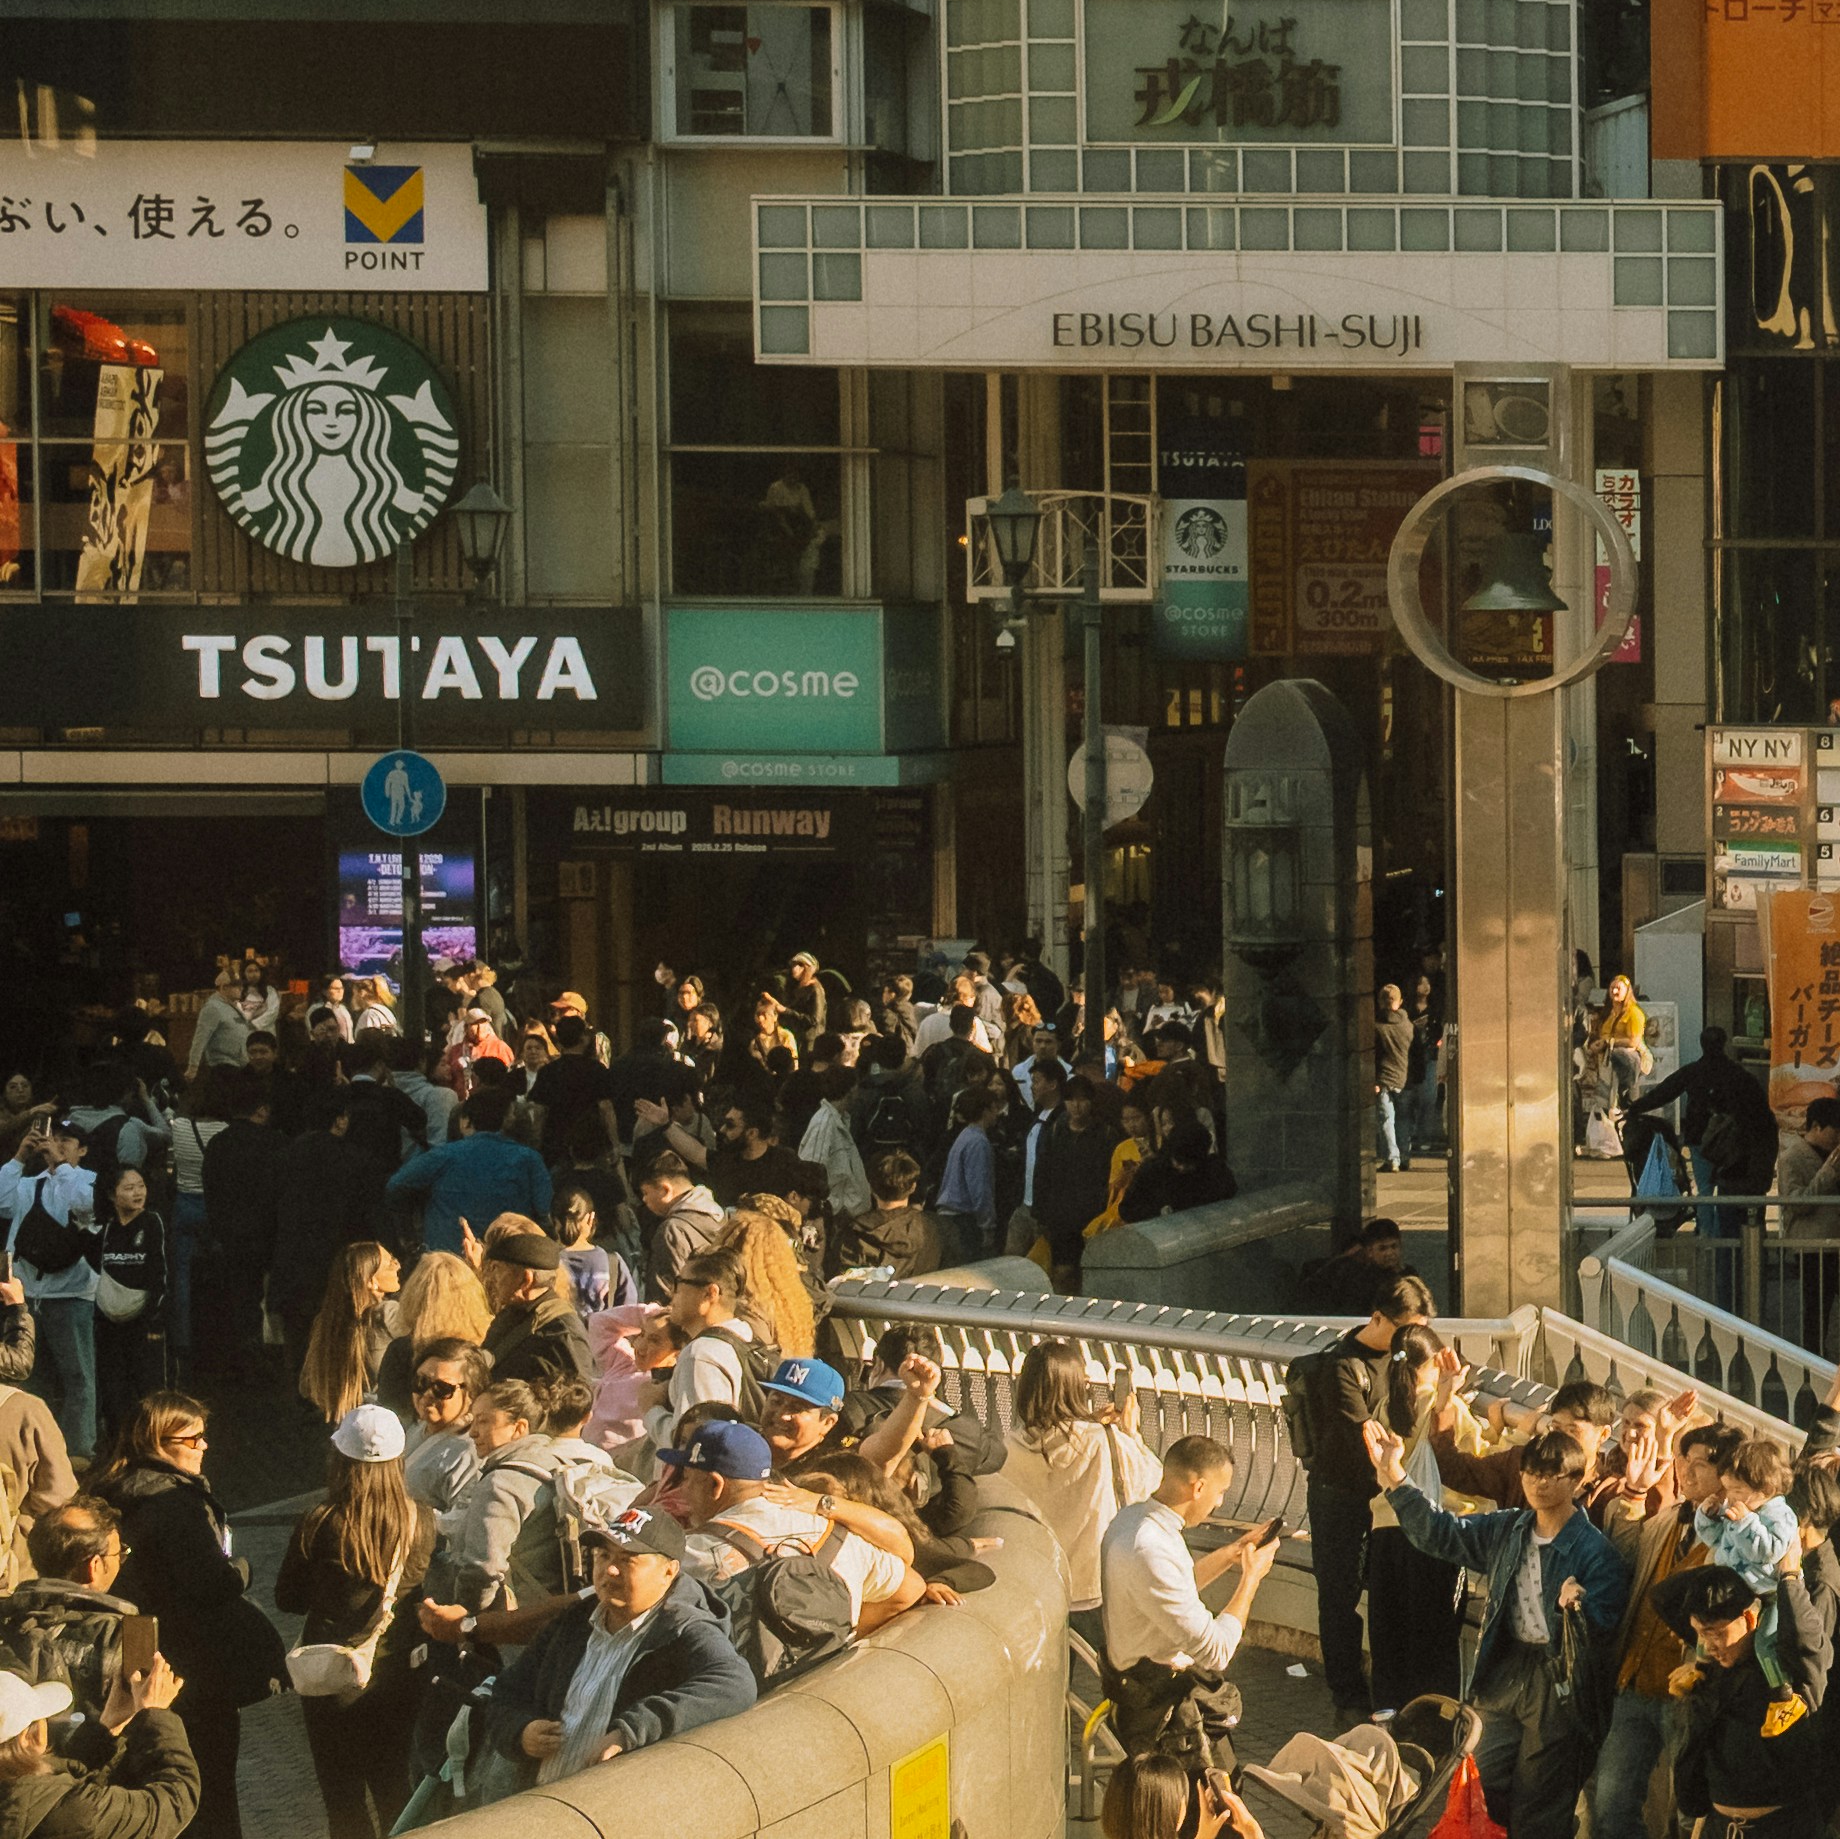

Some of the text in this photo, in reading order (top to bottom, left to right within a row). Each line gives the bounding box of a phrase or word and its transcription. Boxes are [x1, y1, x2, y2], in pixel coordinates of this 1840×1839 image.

[1179, 14, 1297, 55] なんば
[1134, 58, 1342, 128] 戎橋筋
[344, 251, 425, 271] POINT
[1052, 313, 1421, 357] EBISU BASHI-SUJI
[1165, 564, 1239, 575] STARBUCKS
[1164, 605, 1244, 622] @cosme
[1181, 625, 1228, 637] STORE
[182, 635, 598, 700] TSUTAYA
[690, 665, 859, 701] @cosme
[1729, 739, 1791, 758] NY NY
[721, 761, 801, 778] @cosme
[713, 805, 832, 838] Runway
[1820, 809, 1830, 820] 6
[1735, 854, 1796, 869] FamilyMart
[1788, 983, 1815, 1070] バーガー
